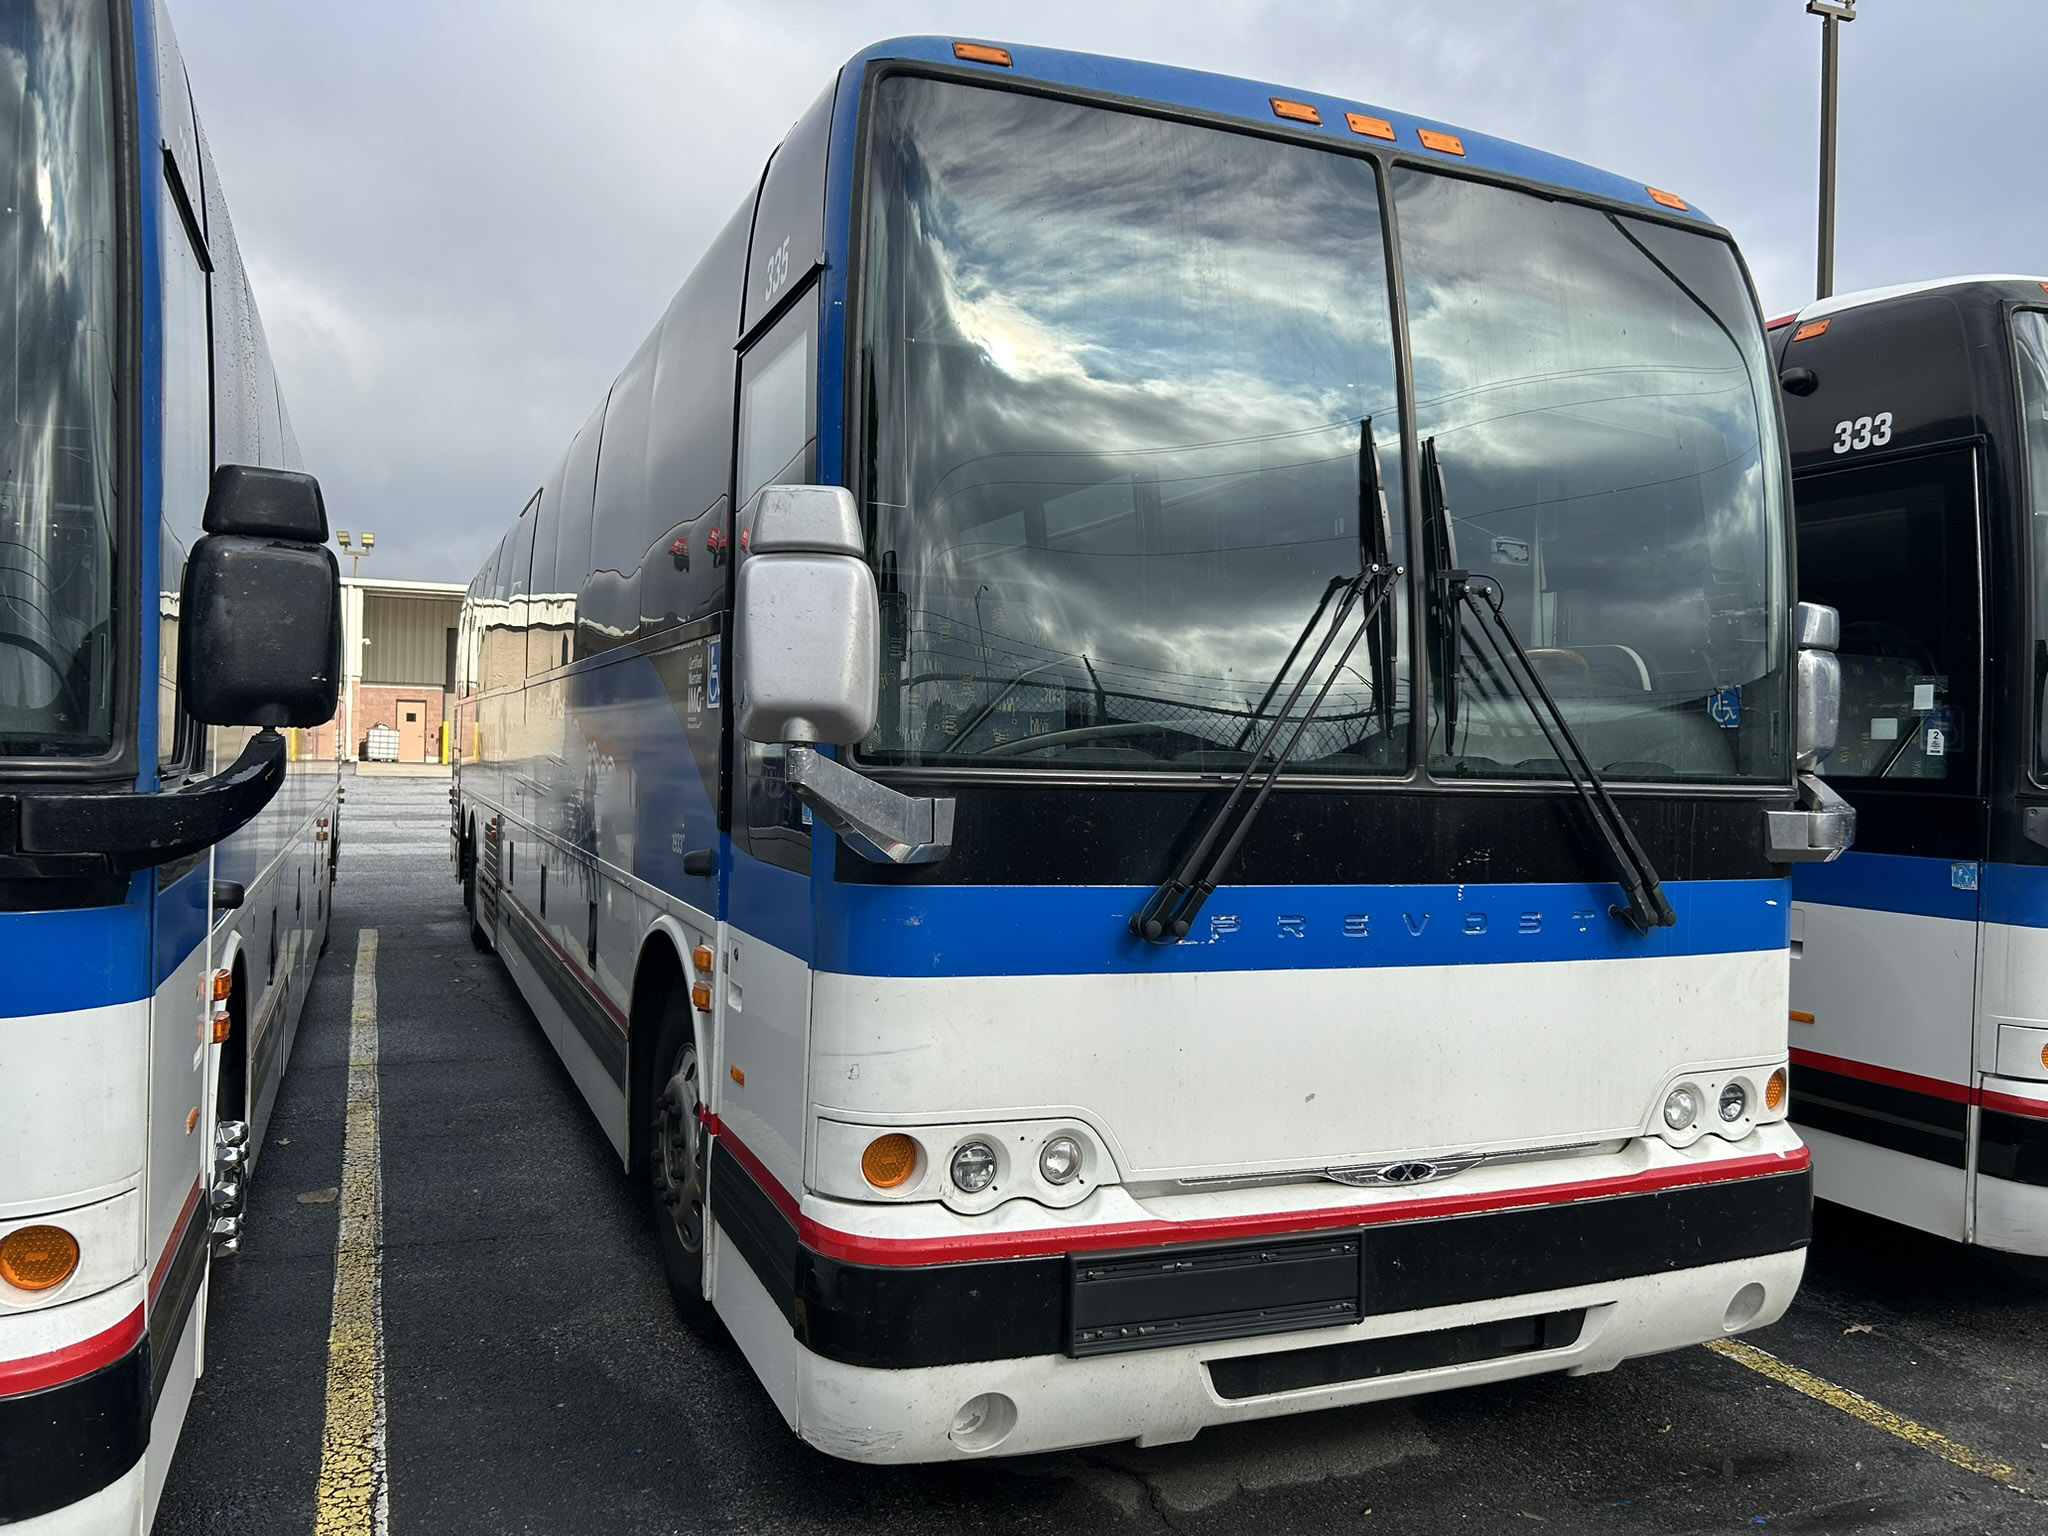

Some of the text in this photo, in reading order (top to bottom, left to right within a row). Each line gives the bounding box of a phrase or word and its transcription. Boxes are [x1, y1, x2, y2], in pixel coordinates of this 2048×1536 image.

[765, 234, 791, 302] 335
[1833, 411, 1893, 454] 333
[1933, 731, 1939, 740] 2
[1210, 911, 1596, 938] PREVOST
